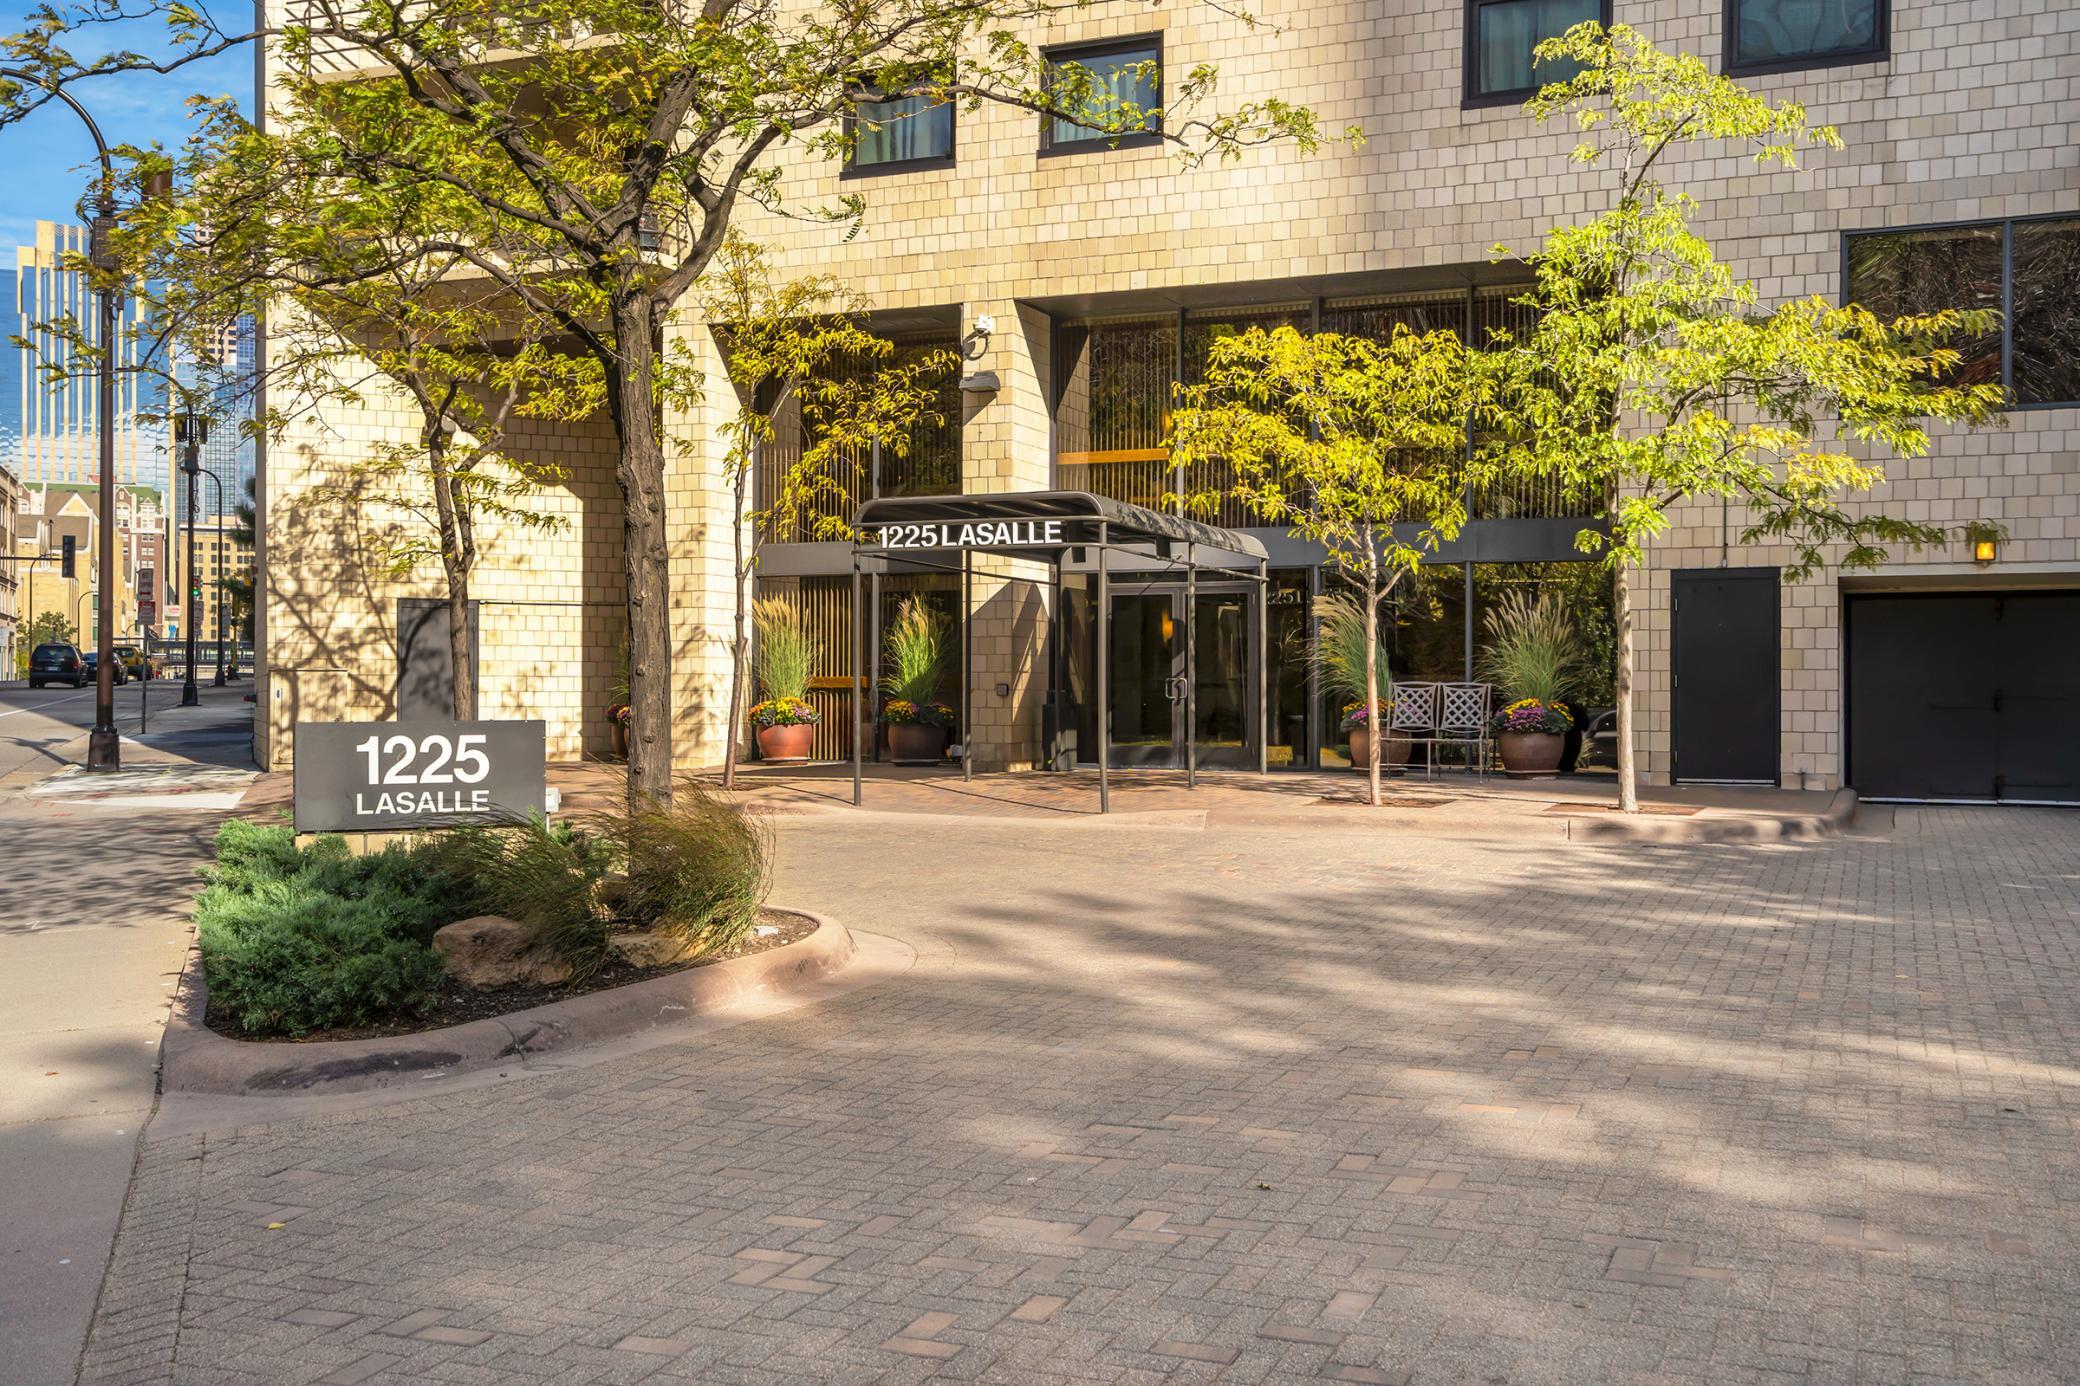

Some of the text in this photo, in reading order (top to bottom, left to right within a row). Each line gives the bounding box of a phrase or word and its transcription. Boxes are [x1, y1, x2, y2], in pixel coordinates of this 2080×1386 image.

[878, 520, 1063, 549] 1225 LASALLE
[356, 734, 490, 785] 1225
[356, 789, 490, 816] LASALLE
